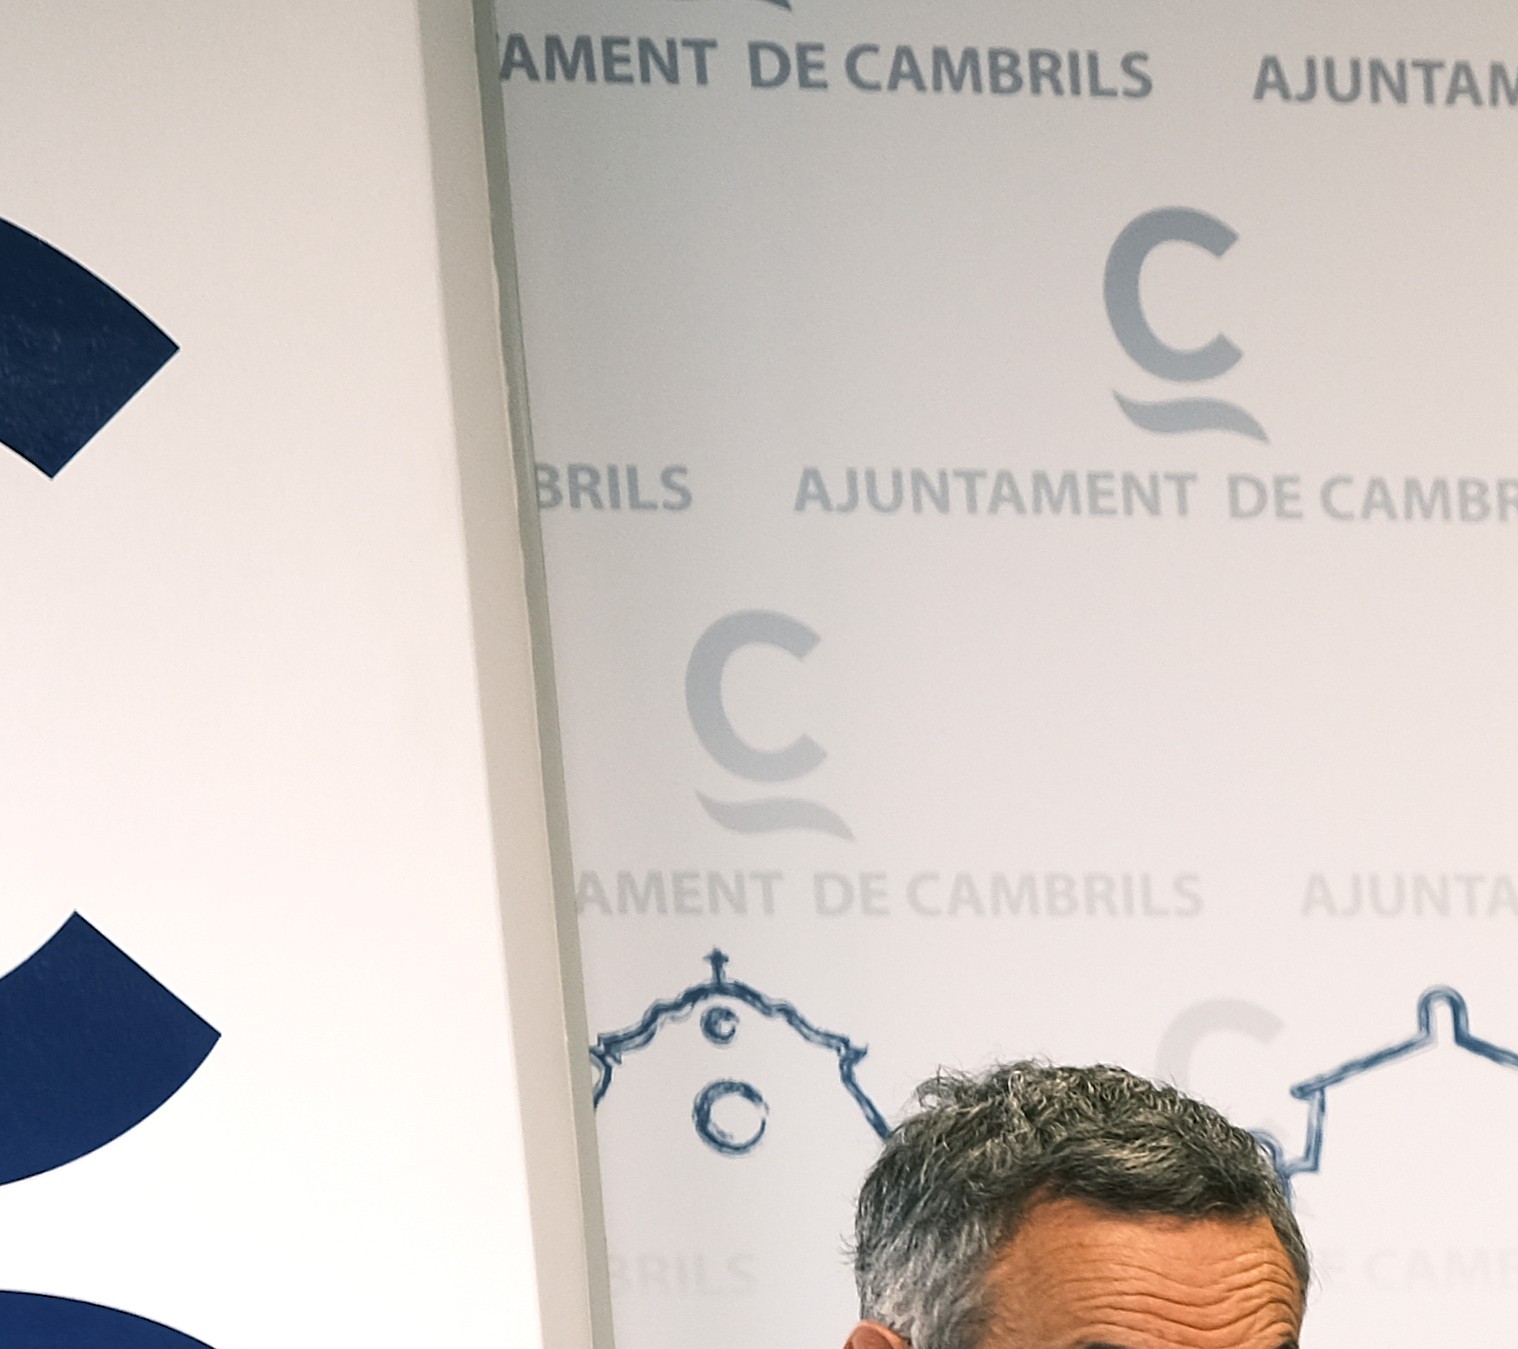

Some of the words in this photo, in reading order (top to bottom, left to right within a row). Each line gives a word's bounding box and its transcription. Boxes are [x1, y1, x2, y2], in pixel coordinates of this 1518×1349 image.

[496, 36, 718, 90] AMENT
[747, 43, 832, 93] DE
[846, 43, 1154, 101] CAMBRILS
[793, 467, 1196, 520] AJUNTAMENT
[1226, 472, 1305, 522] DE
[813, 871, 891, 918] DE
[906, 871, 1203, 922] CAMBRILS
